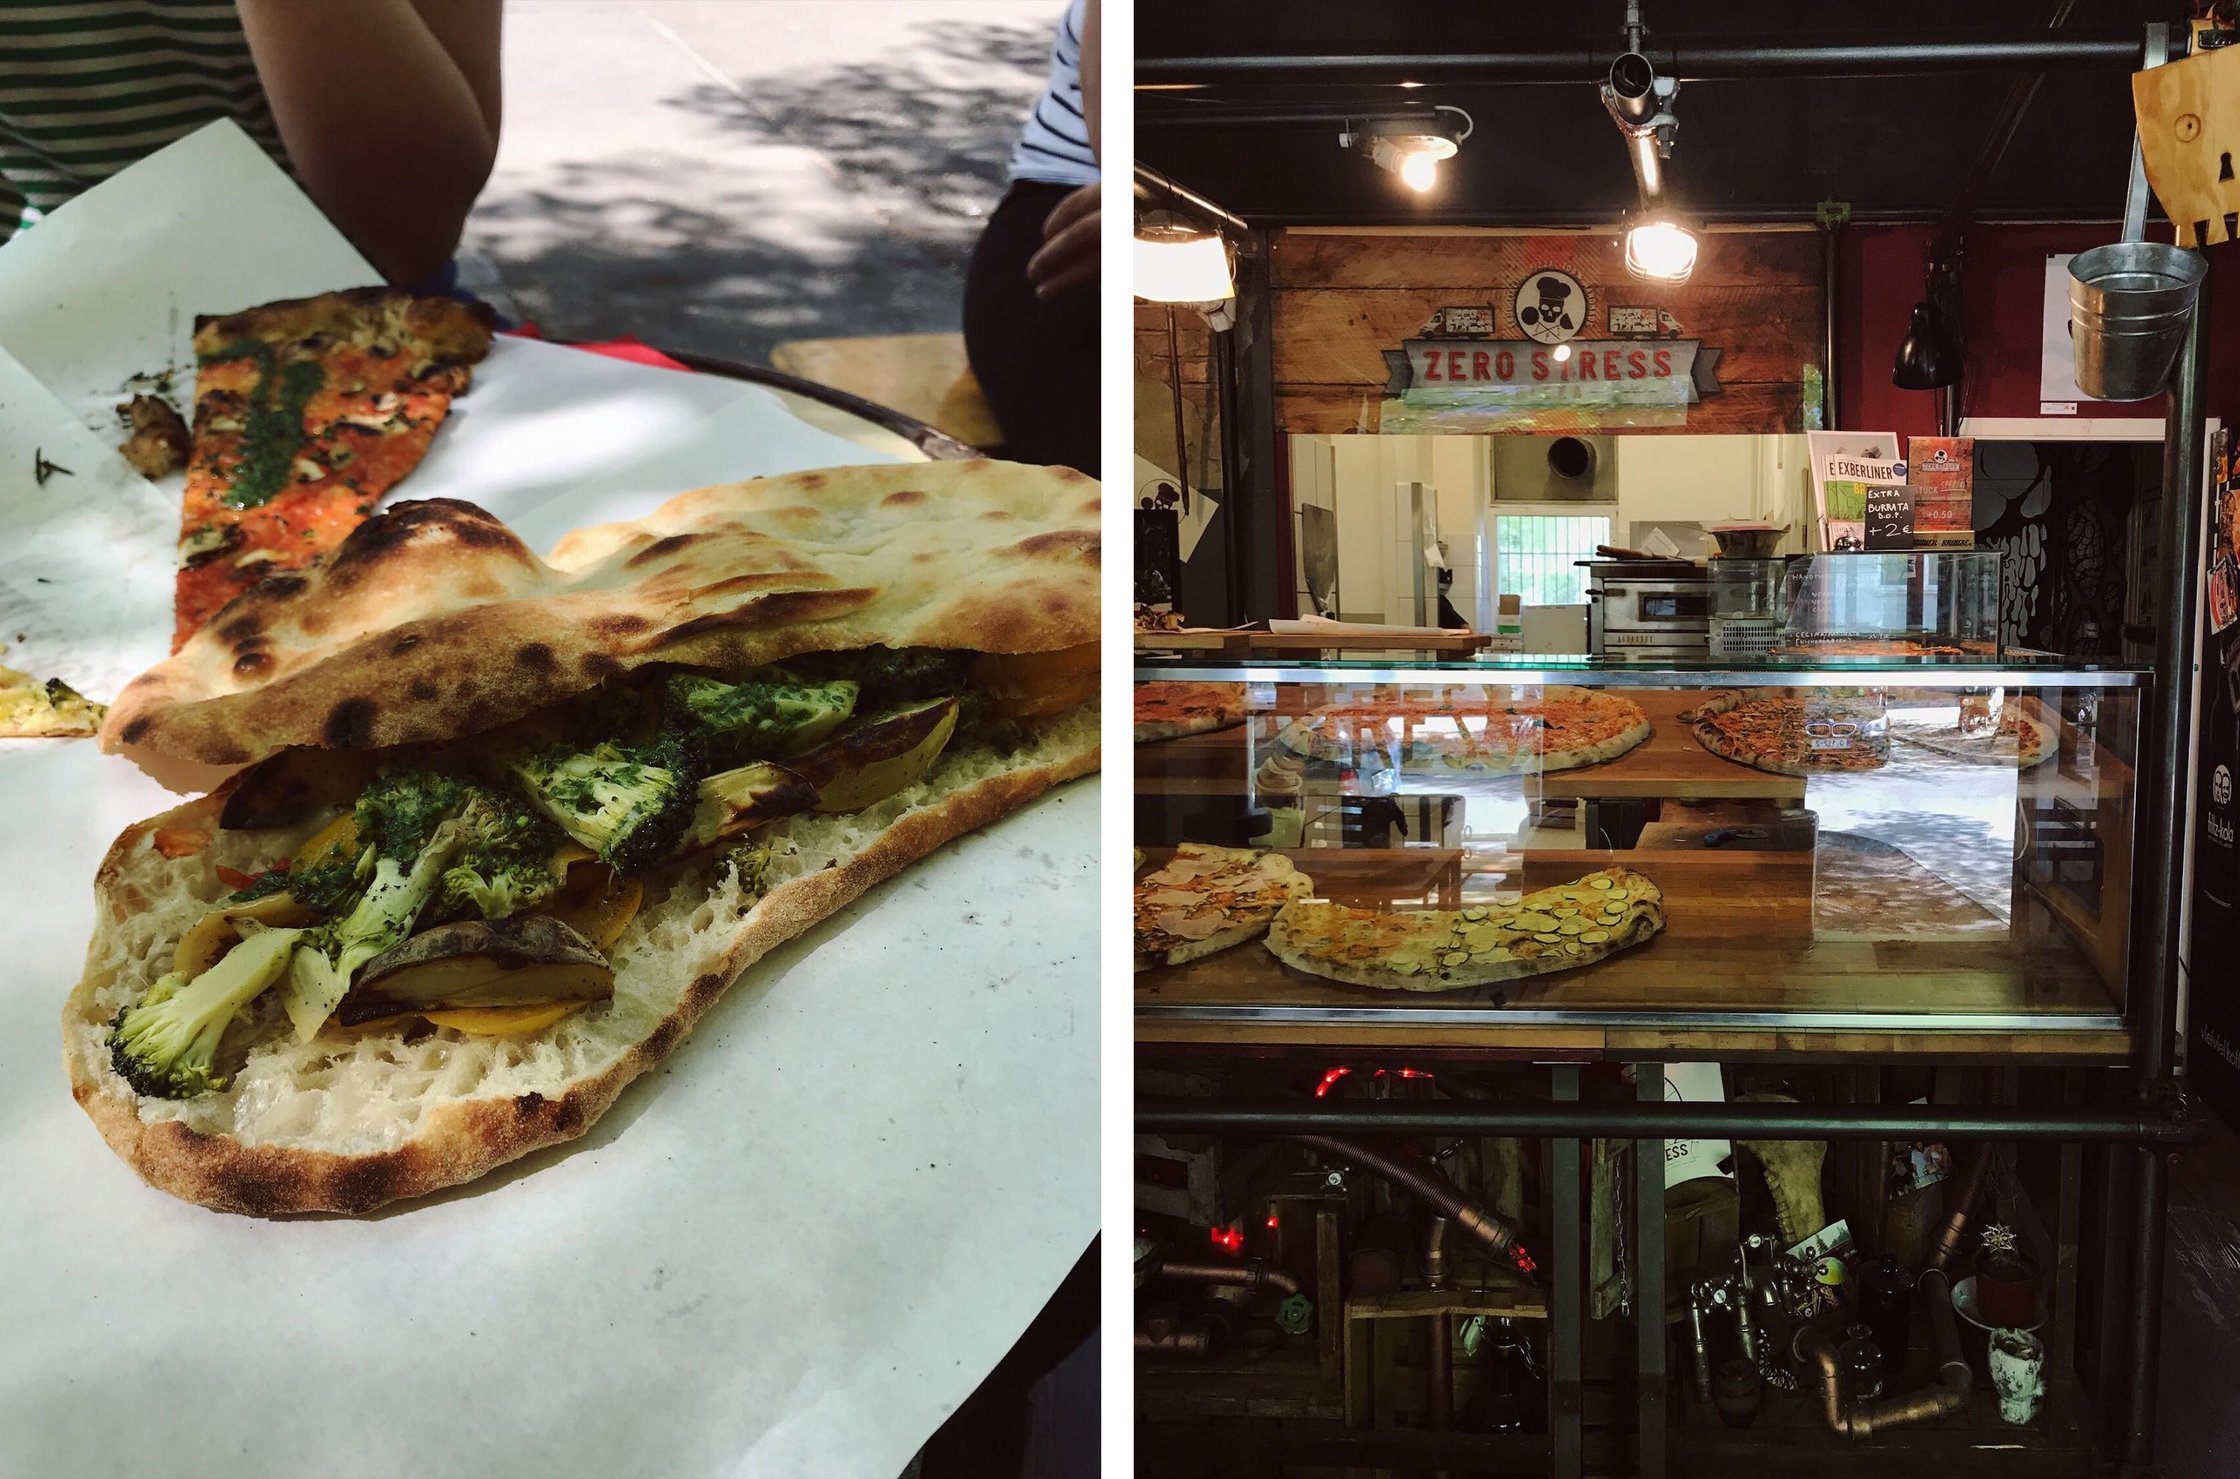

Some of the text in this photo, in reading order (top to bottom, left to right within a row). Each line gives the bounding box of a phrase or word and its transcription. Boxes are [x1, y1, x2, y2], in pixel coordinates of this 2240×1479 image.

[1424, 350, 1672, 381] ZERO STRESS
[1838, 461, 1893, 479] EXBERLINER
[1853, 483, 1866, 494] BR
[1868, 490, 1900, 499] EXTRA
[1868, 503, 1909, 513] BURRATA
[1926, 510, 1953, 519] +0.50
[2207, 811, 2234, 842] fritz-kola
[1665, 1143, 1688, 1162] ESS
